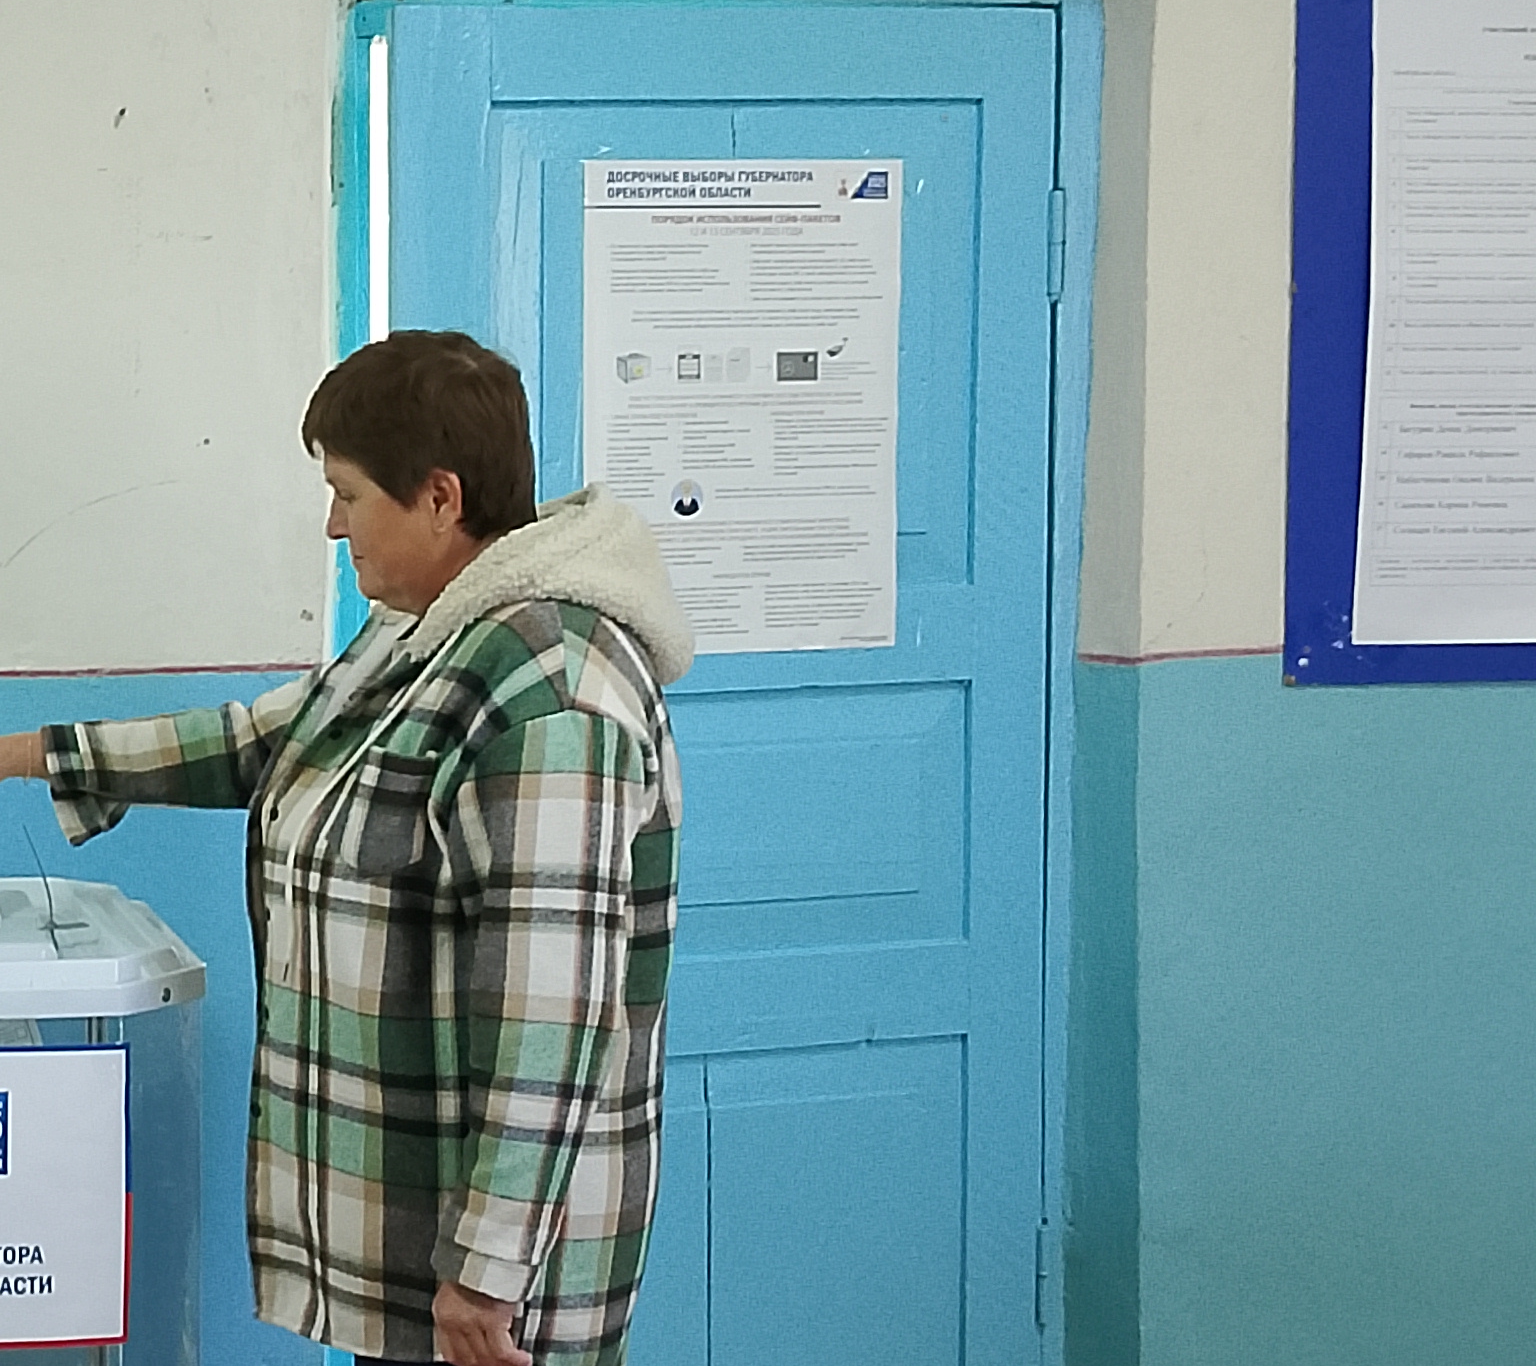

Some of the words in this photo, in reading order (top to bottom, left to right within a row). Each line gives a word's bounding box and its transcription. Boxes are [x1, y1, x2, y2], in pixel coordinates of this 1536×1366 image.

[607, 171, 679, 183] ДОСРОЧНЫЕ
[682, 171, 735, 183] ВЫБОРЫ
[738, 171, 814, 182] ГУБЕРНАТОРА
[607, 185, 696, 199] ОРЕНБУРГСКОЙ
[699, 186, 751, 198] ОБЛАСТИ
